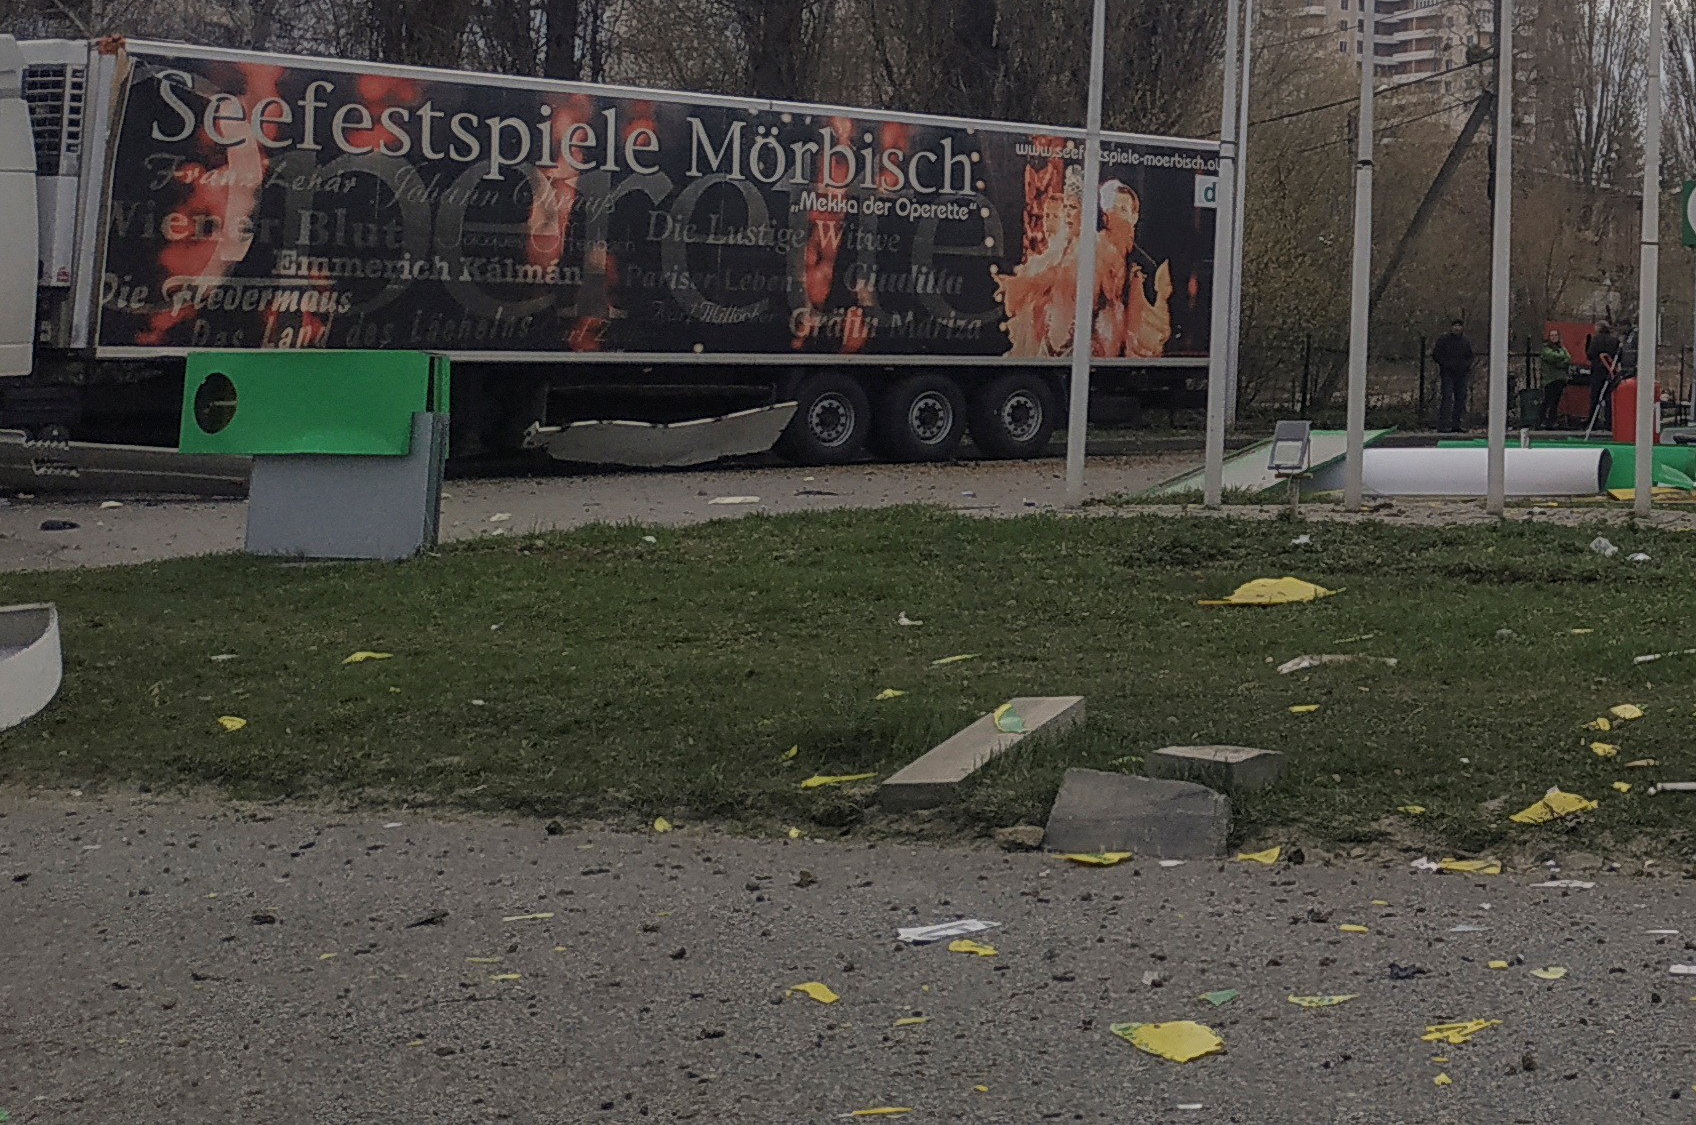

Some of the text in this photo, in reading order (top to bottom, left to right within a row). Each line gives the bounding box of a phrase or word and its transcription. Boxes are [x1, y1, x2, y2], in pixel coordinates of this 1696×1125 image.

[150, 69, 978, 197] Seefestspiele Mörbisch
[861, 196, 892, 217] der
[295, 208, 405, 250] Blut
[646, 209, 901, 254] Die Lustige Witwe
[271, 249, 452, 282] Emmerich
[261, 312, 335, 348] Land
